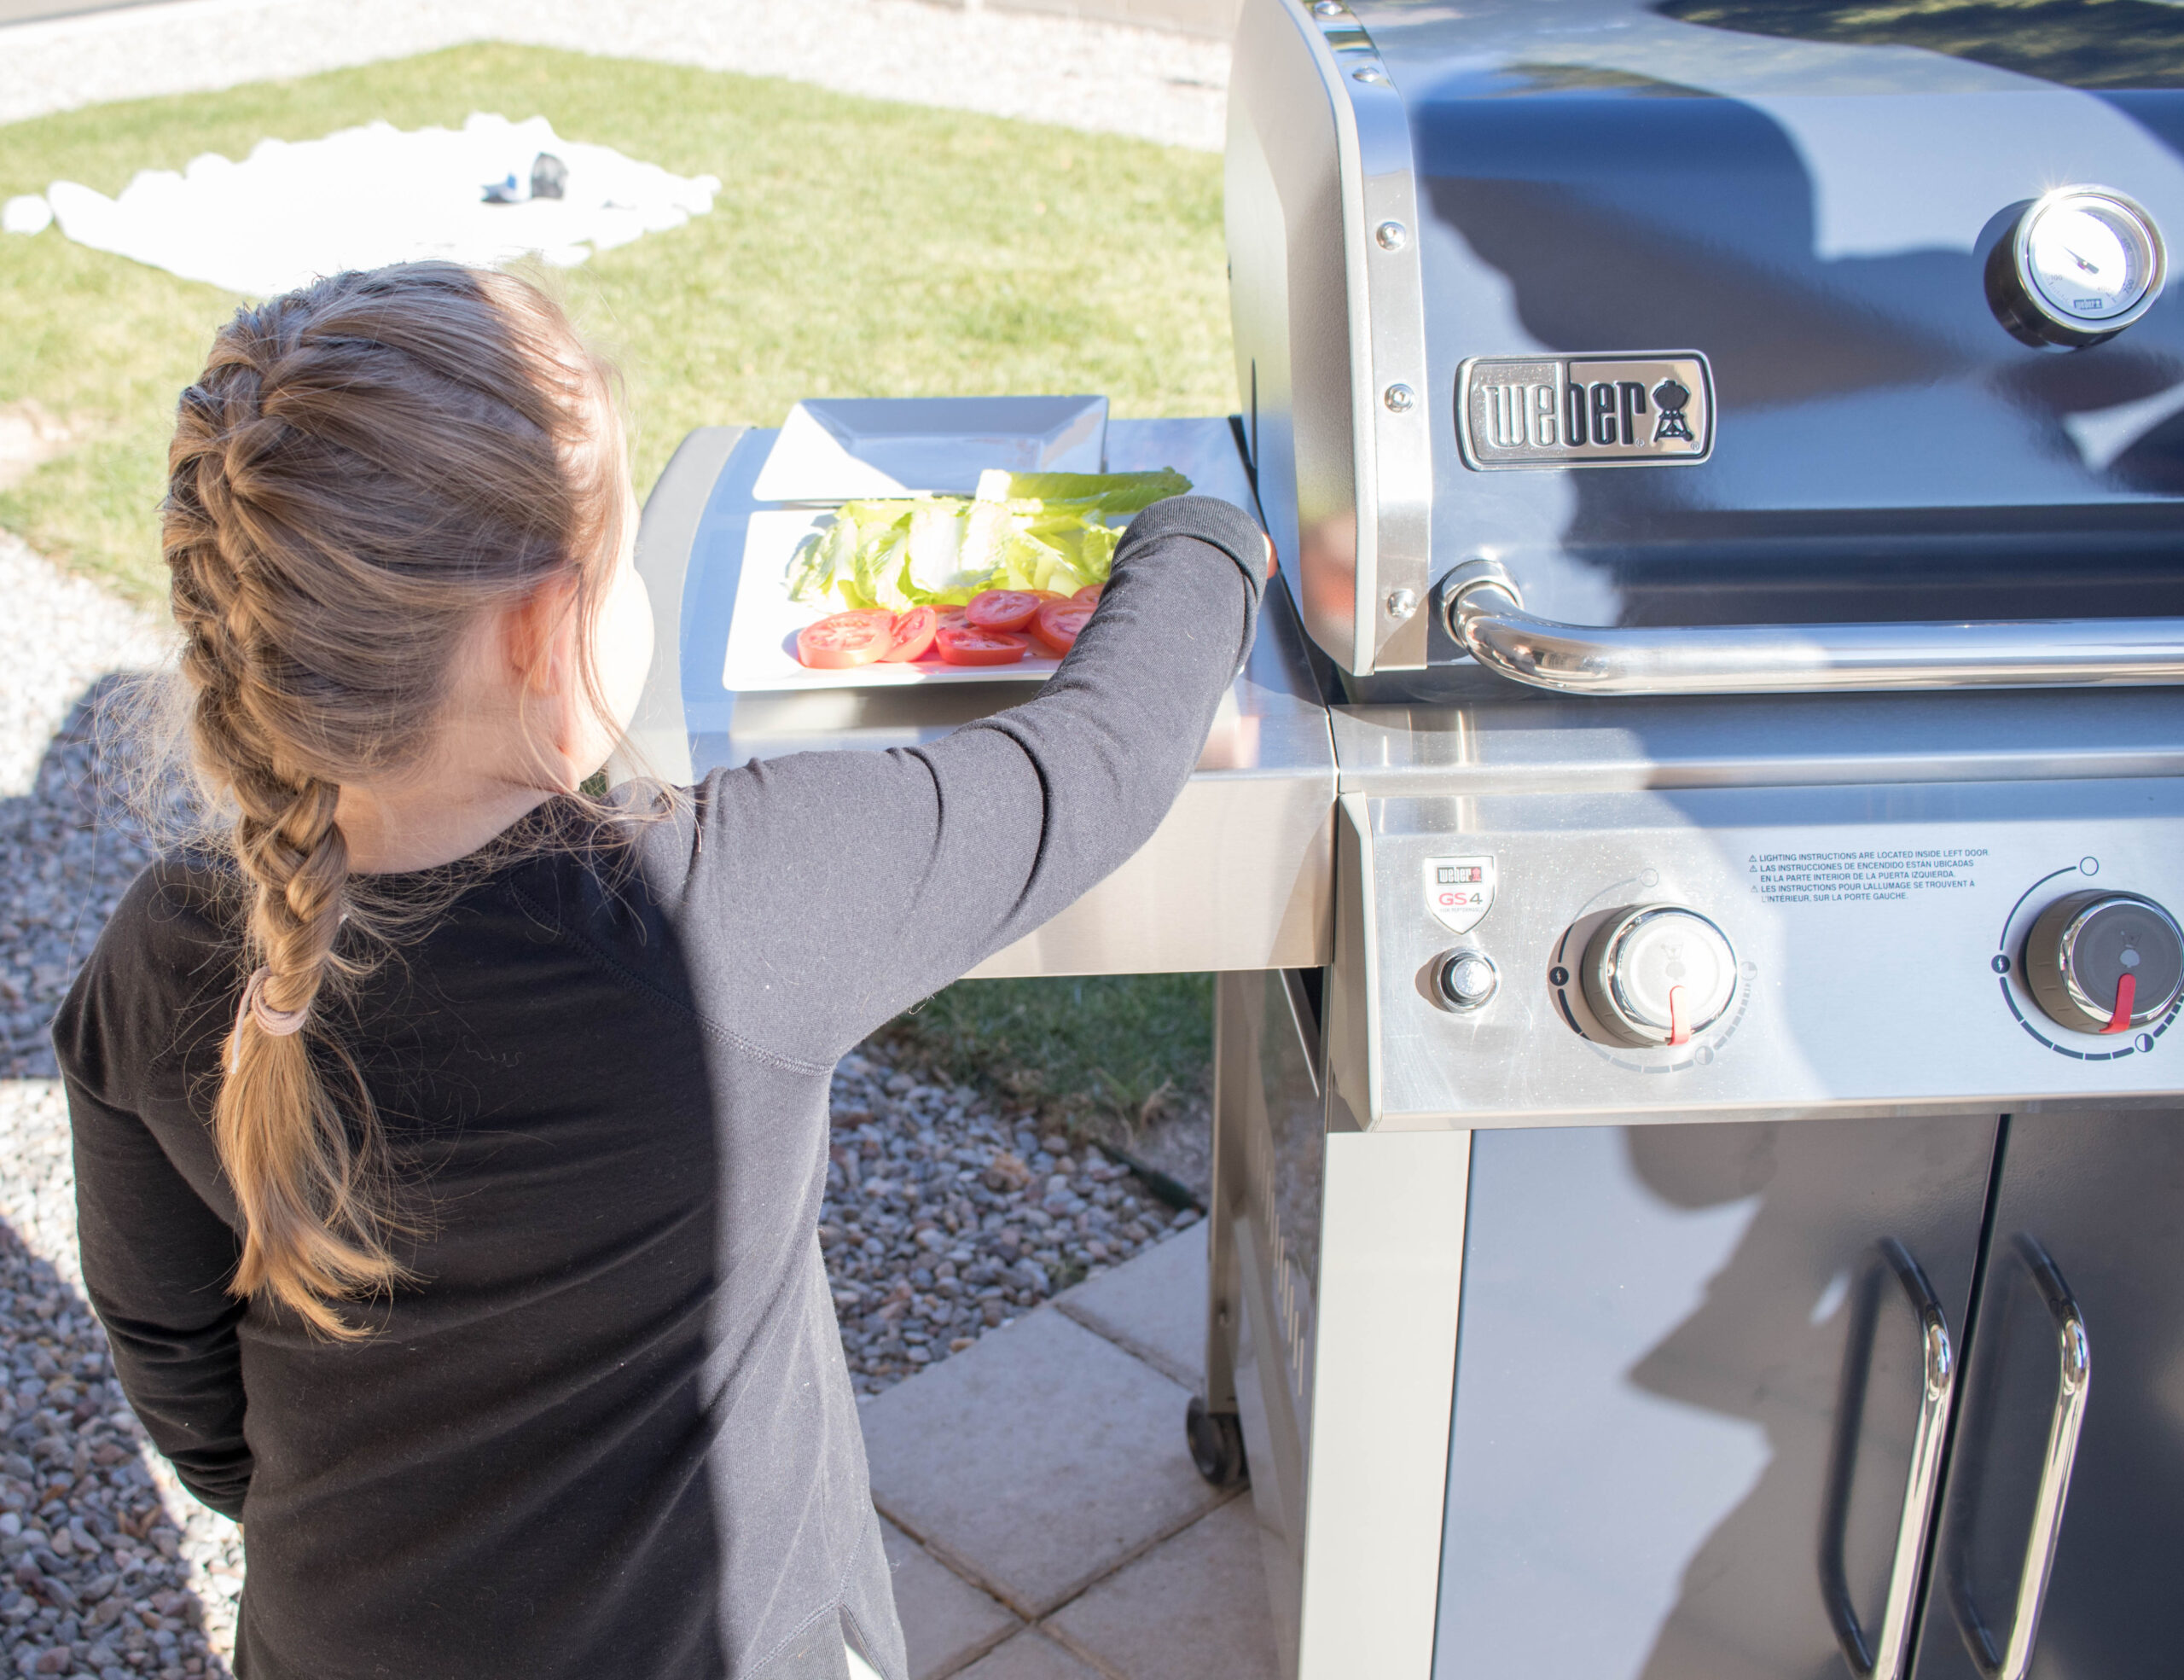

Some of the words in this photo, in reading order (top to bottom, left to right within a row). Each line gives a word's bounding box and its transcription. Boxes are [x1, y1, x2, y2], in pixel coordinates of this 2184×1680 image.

[1482, 362, 1647, 448] weber
[1799, 852, 1856, 861] INSTRUCTIONS
[1926, 880, 1967, 888] TROUVENT
